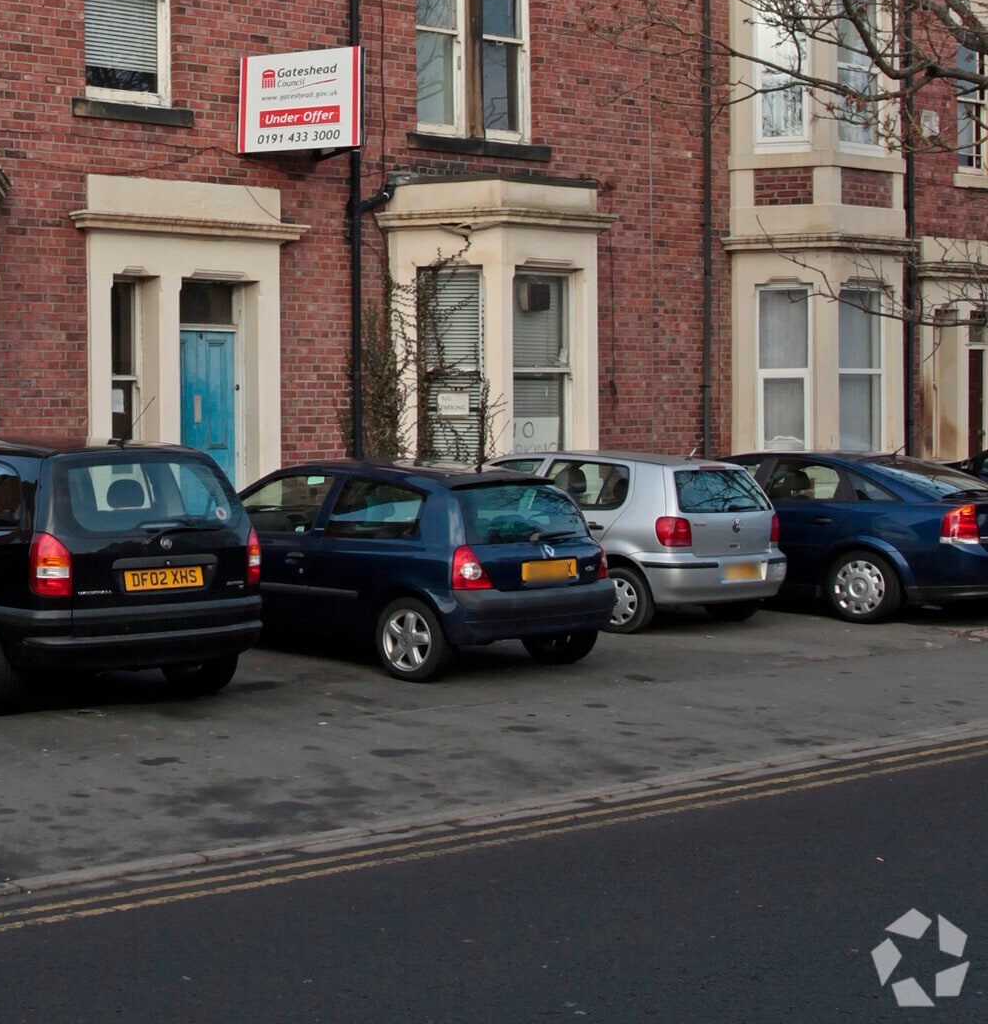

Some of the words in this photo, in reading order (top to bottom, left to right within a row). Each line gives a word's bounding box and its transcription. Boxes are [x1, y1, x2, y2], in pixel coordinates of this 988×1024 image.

[277, 63, 337, 78] Gateshead
[277, 79, 305, 88] Council
[261, 90, 338, 102] www.gateshead.gov.uk
[265, 112, 300, 124] Under
[302, 110, 334, 123] Offer
[257, 133, 284, 145] 0191
[288, 131, 308, 143] 433
[312, 129, 340, 141] 3000
[131, 571, 168, 587] DF02
[172, 569, 198, 585] XHS
